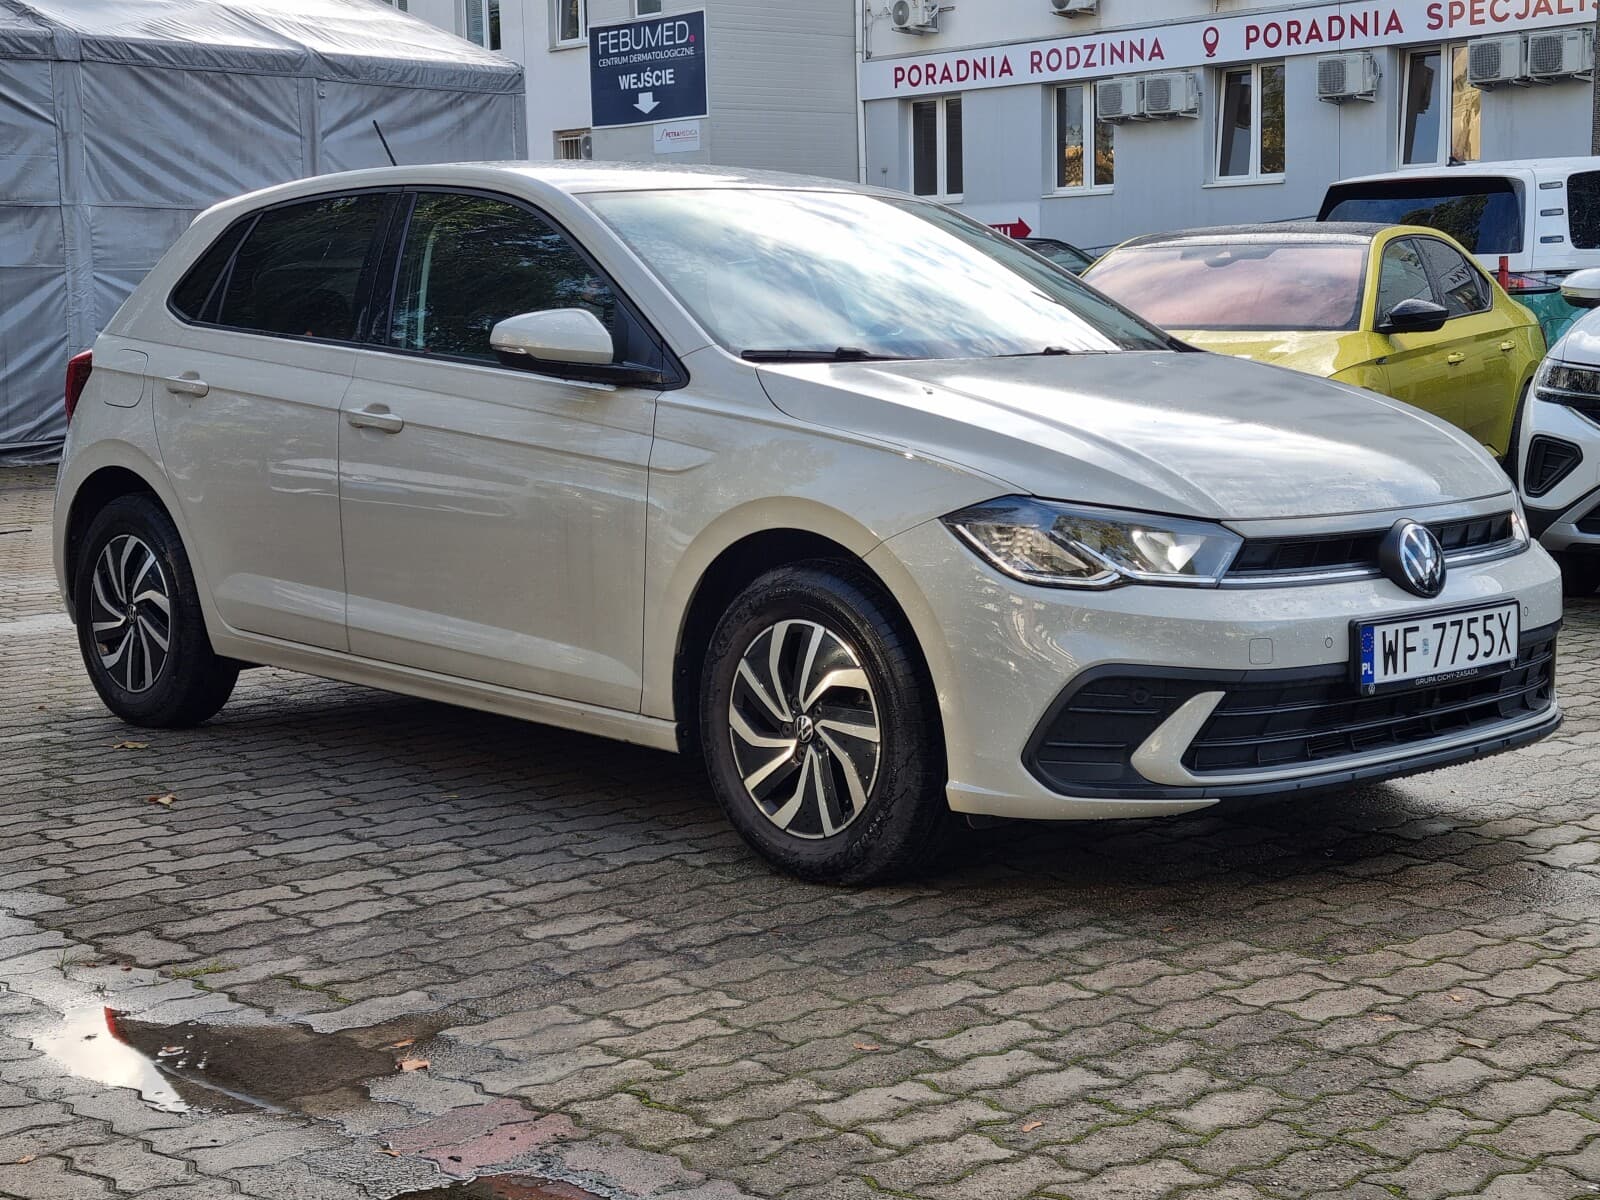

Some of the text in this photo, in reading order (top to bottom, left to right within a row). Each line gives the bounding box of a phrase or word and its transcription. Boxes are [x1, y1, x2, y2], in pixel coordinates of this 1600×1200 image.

[1245, 9, 1404, 50] PORADNIA
[598, 46, 695, 67] CENTRUM DERMATOLOGICZNE
[894, 37, 1165, 89] PORADNIA RODZINNA
[618, 67, 675, 90] WEJŚCIE
[1382, 611, 1511, 676] WF 7755X
[1361, 662, 1373, 676] PL
[1415, 668, 1479, 686] GRUPA CICHY-ZASADA
